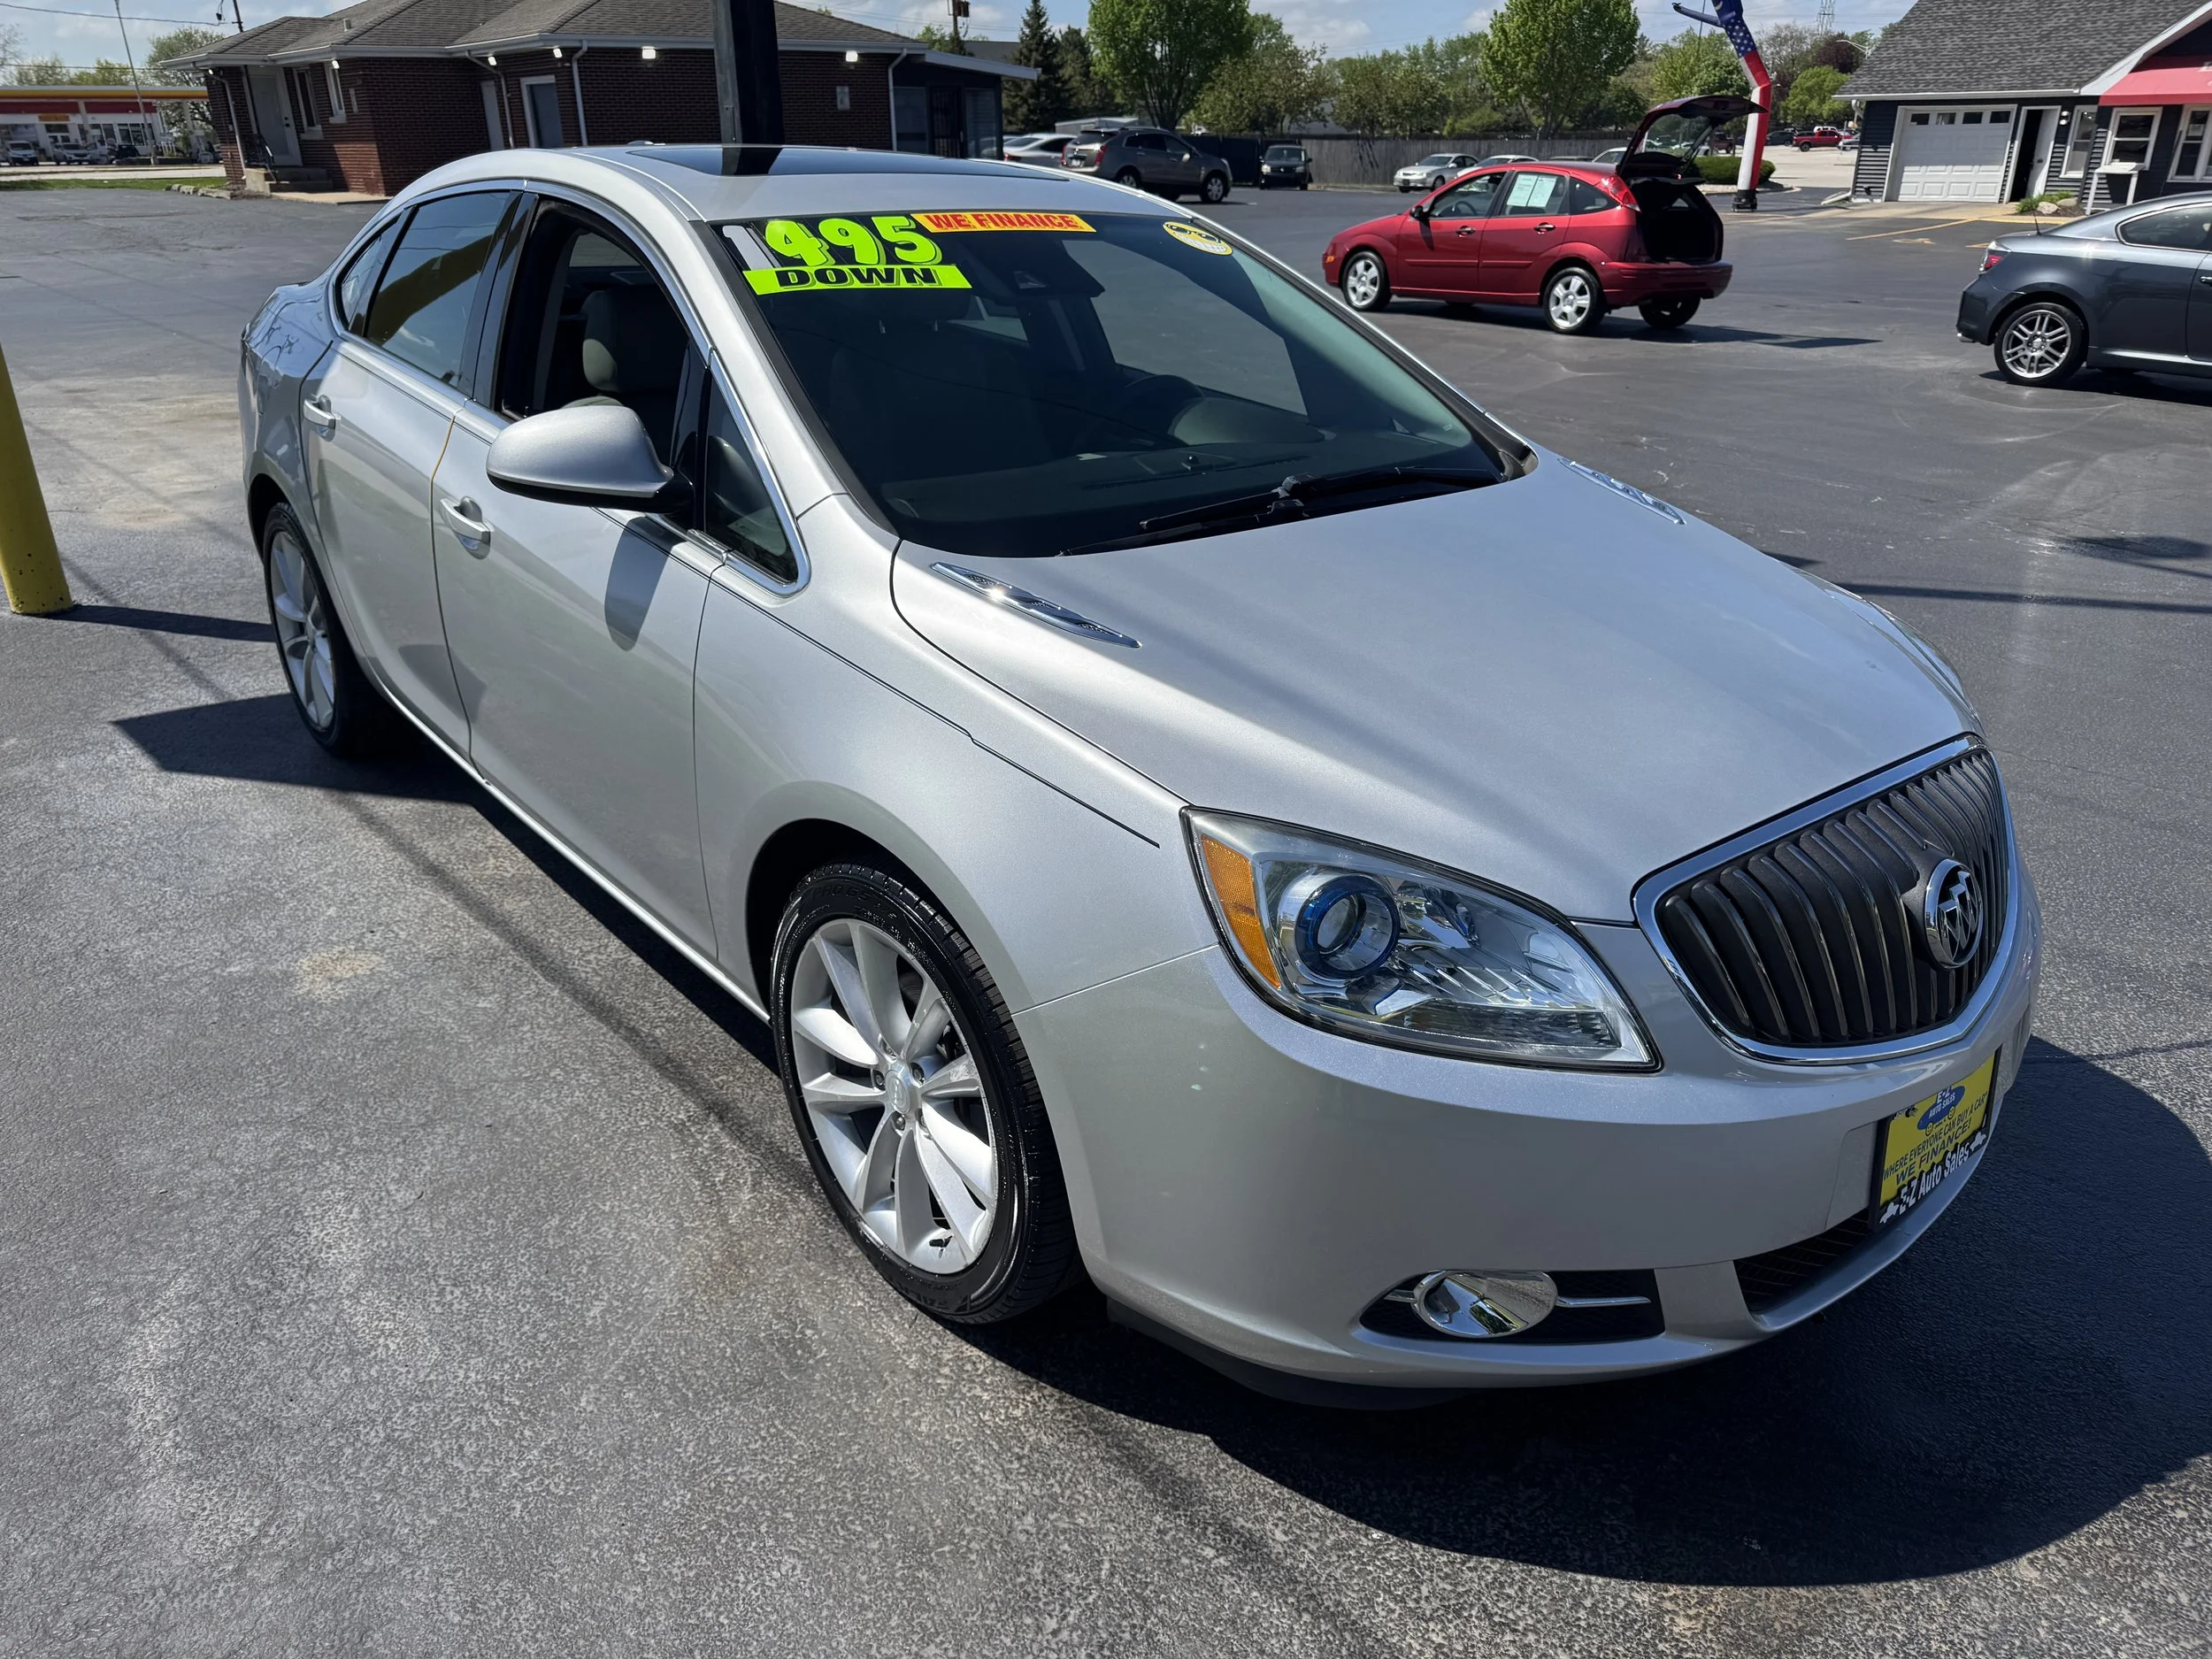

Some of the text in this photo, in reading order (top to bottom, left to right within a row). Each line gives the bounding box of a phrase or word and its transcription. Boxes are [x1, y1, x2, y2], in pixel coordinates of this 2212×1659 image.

[924, 214, 1081, 230] WE FINANCE
[775, 266, 944, 288] DOWN
[1929, 1092, 1955, 1118] AUTO SALES
[1944, 1116, 1957, 1135] CAN
[1896, 1117, 1972, 1186] WE FINANCE!
[1917, 1164, 1942, 1200] Auto
[1944, 1142, 1970, 1178] Sales
